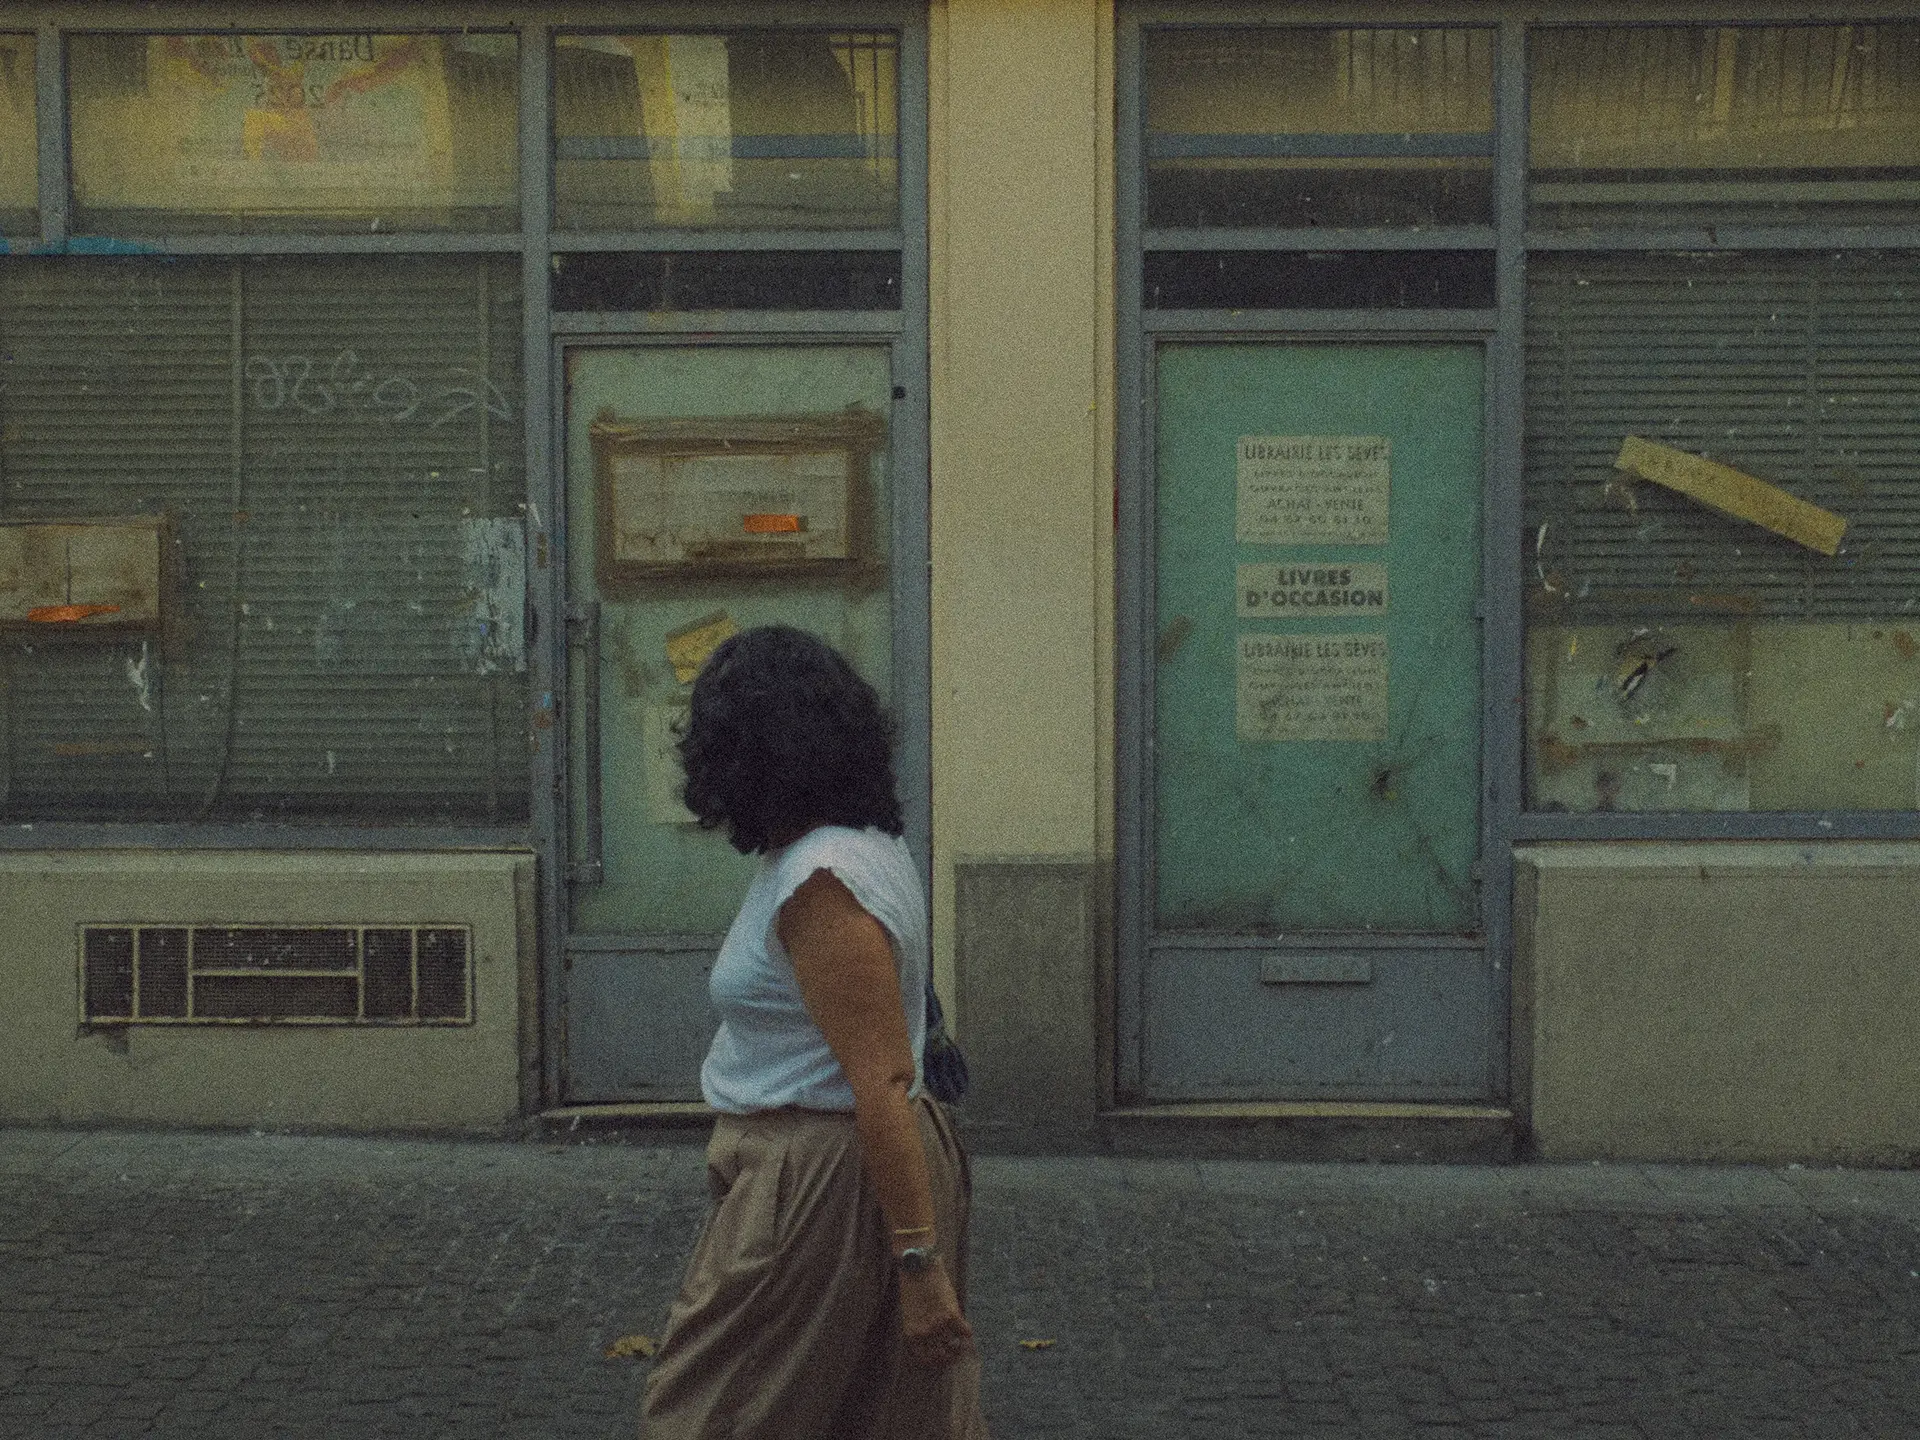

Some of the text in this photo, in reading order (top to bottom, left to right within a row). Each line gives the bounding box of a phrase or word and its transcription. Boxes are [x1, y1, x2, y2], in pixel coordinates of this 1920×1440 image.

[1244, 444, 1312, 460] LIBRAIRIE
[1319, 444, 1341, 460] LES
[1267, 498, 1311, 510] ACHAT
[1325, 498, 1364, 511] VENTE
[1278, 569, 1351, 586] LIVRES
[1246, 590, 1383, 607] D'OCCASION
[1244, 642, 1311, 658] LIBRAIRIE
[1317, 642, 1340, 658] LES
